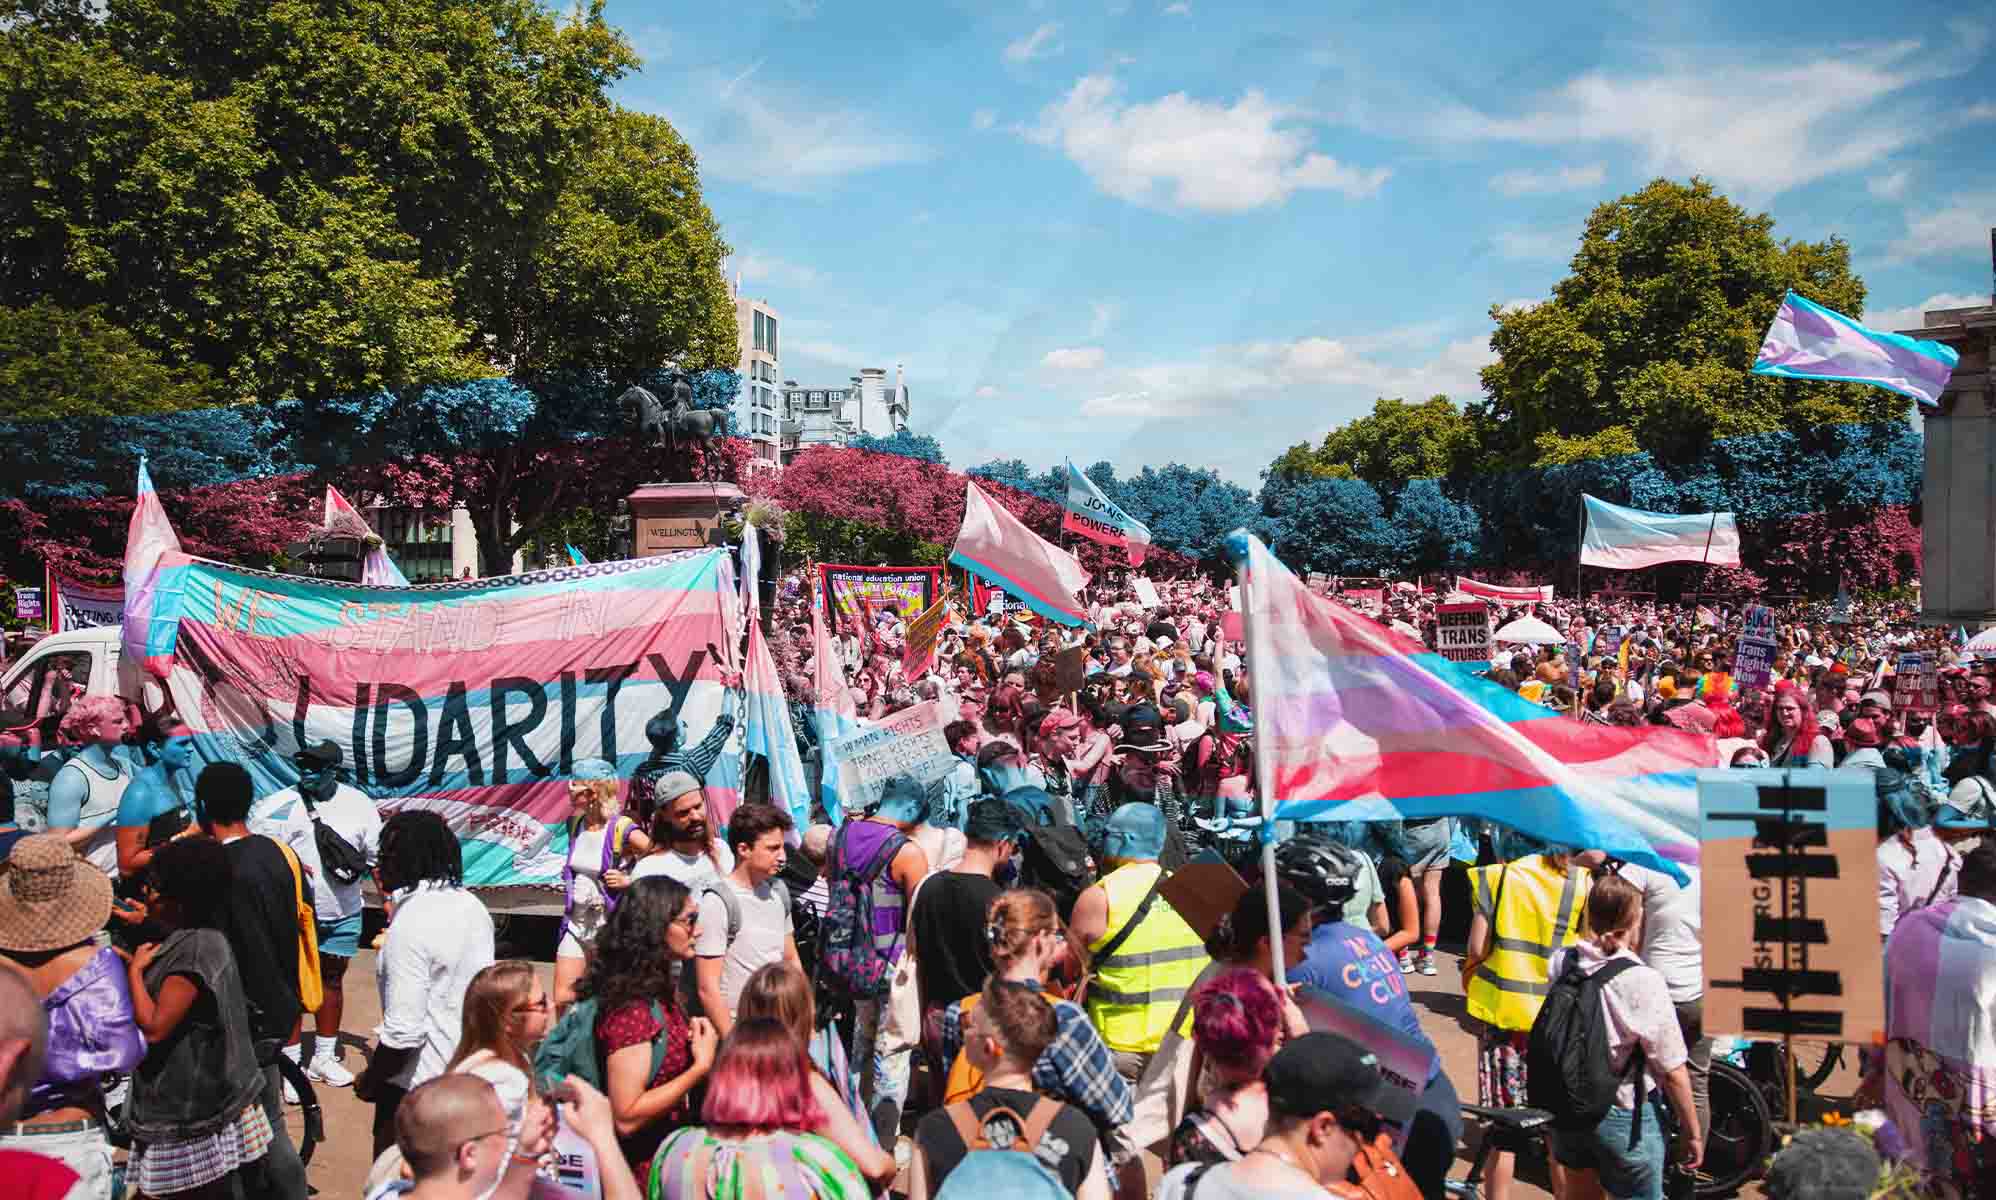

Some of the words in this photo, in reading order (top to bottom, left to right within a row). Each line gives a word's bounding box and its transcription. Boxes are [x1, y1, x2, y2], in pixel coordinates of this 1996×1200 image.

[865, 573, 902, 582] education
[905, 572, 926, 581] union
[17, 600, 41, 609] Rights
[214, 578, 290, 641] WE
[1440, 611, 1485, 626] DEFEND
[1441, 628, 1487, 645] TRANS
[1442, 647, 1488, 661] FUTURES
[1738, 641, 1767, 657] Trans
[1736, 656, 1771, 673] Rights
[1735, 668, 1758, 683] Now
